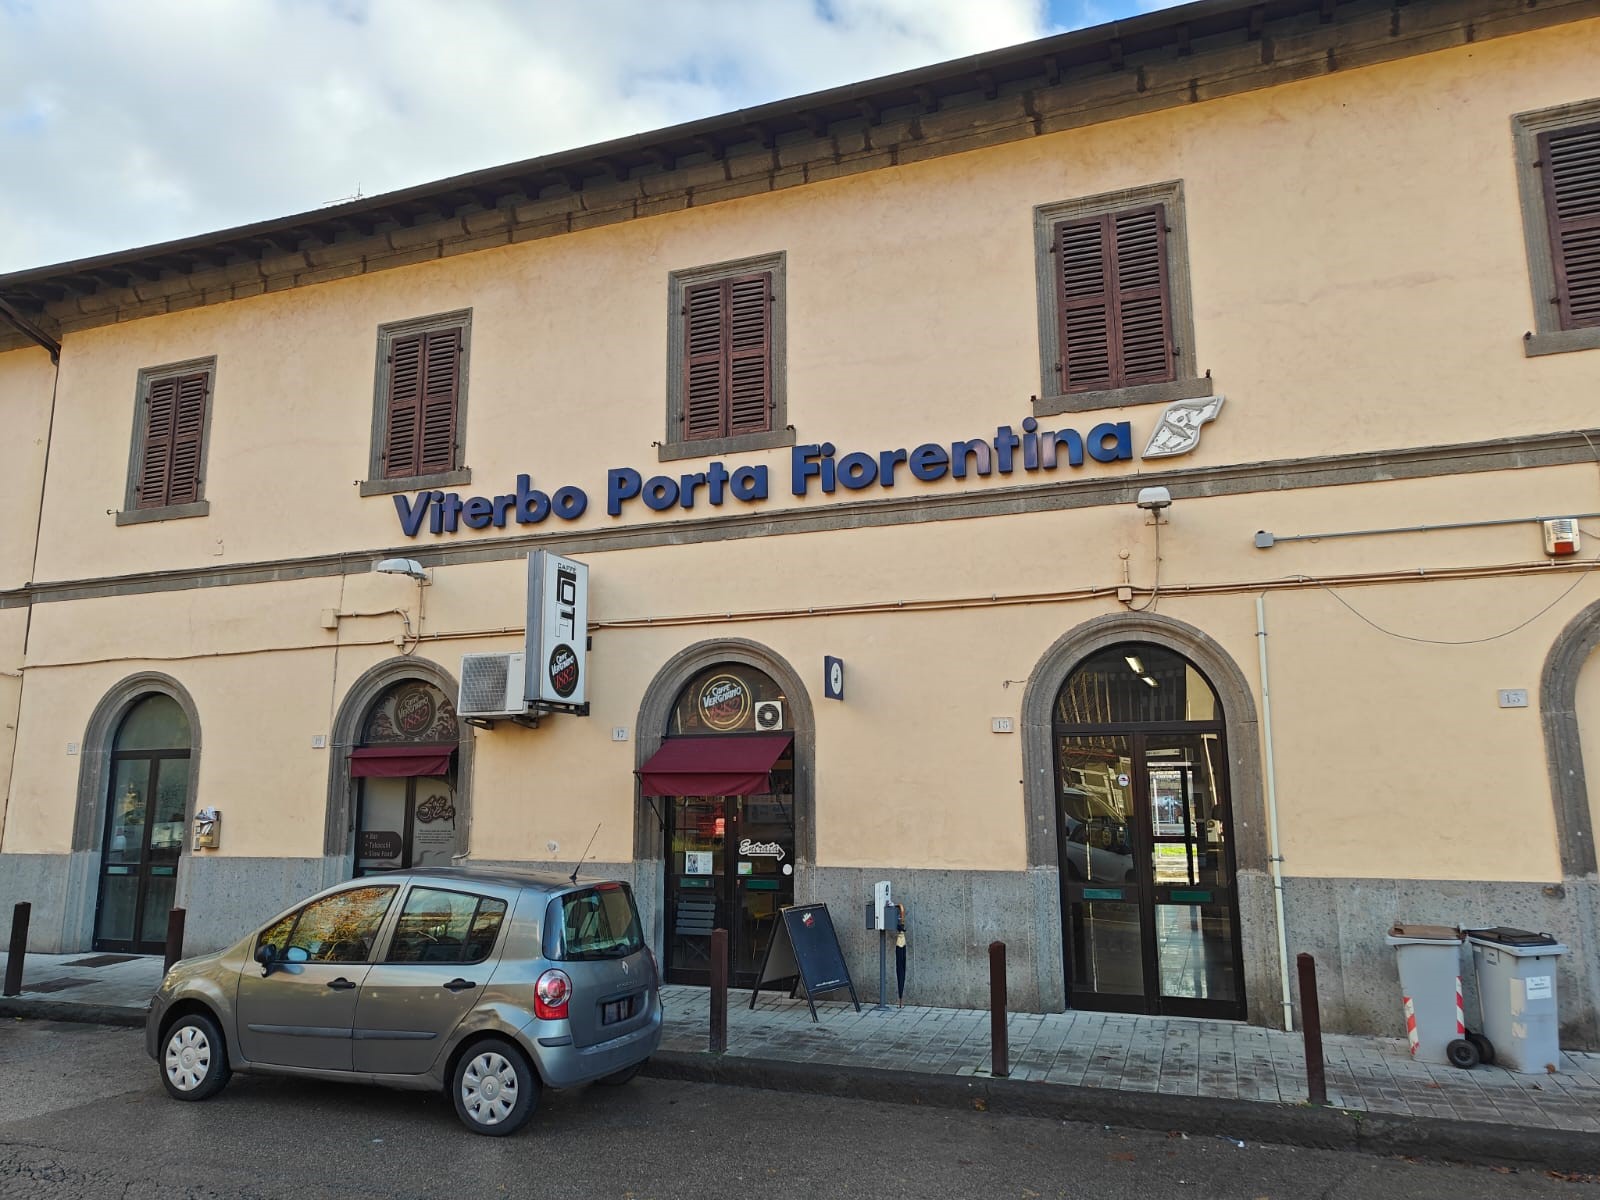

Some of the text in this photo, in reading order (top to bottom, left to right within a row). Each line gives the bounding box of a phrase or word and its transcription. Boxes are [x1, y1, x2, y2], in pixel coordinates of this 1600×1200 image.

[393, 416, 1133, 536] Viterbo Porta Fiorentina
[554, 667, 576, 690] 1882
[739, 839, 780, 855] Entrata
